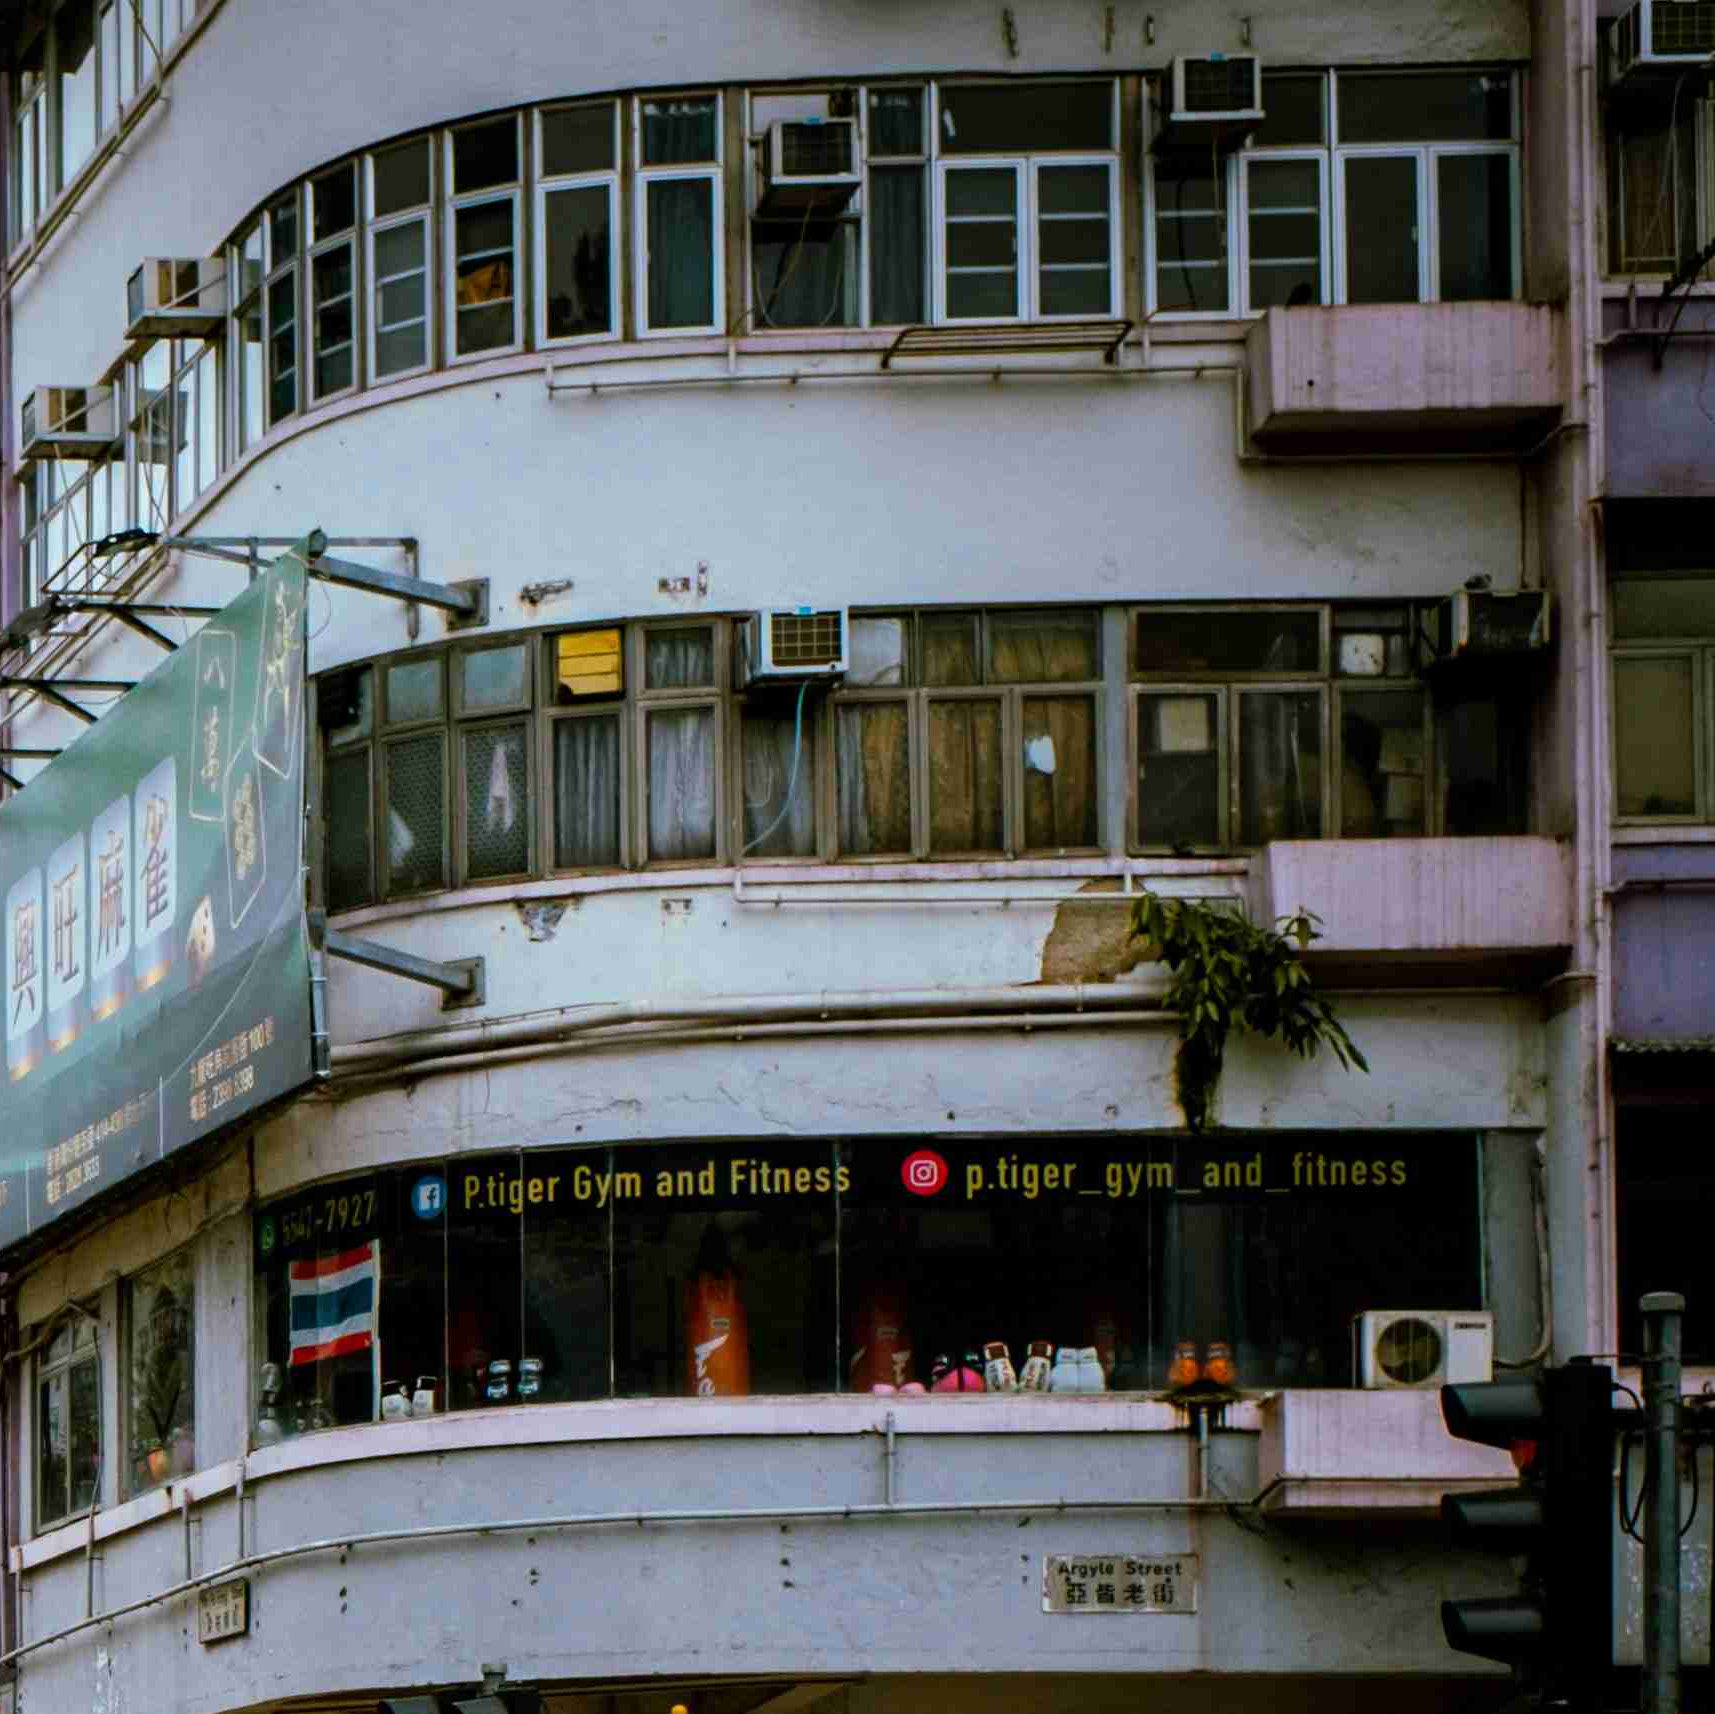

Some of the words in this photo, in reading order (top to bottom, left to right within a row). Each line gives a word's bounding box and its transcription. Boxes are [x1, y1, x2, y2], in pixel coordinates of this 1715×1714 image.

[12, 792, 169, 1025] 興旺麻雀
[464, 1171, 561, 1215] P.tiger
[573, 1165, 643, 1208] Gym
[656, 1160, 716, 1198] and
[731, 1158, 852, 1196] Fitness
[966, 1151, 1408, 1199] p.tiger_gym_and_fitness
[1059, 1561, 1115, 1577] Argyle
[1125, 1561, 1182, 1576] Street
[1065, 1582, 1175, 1605] 亞皆老街
